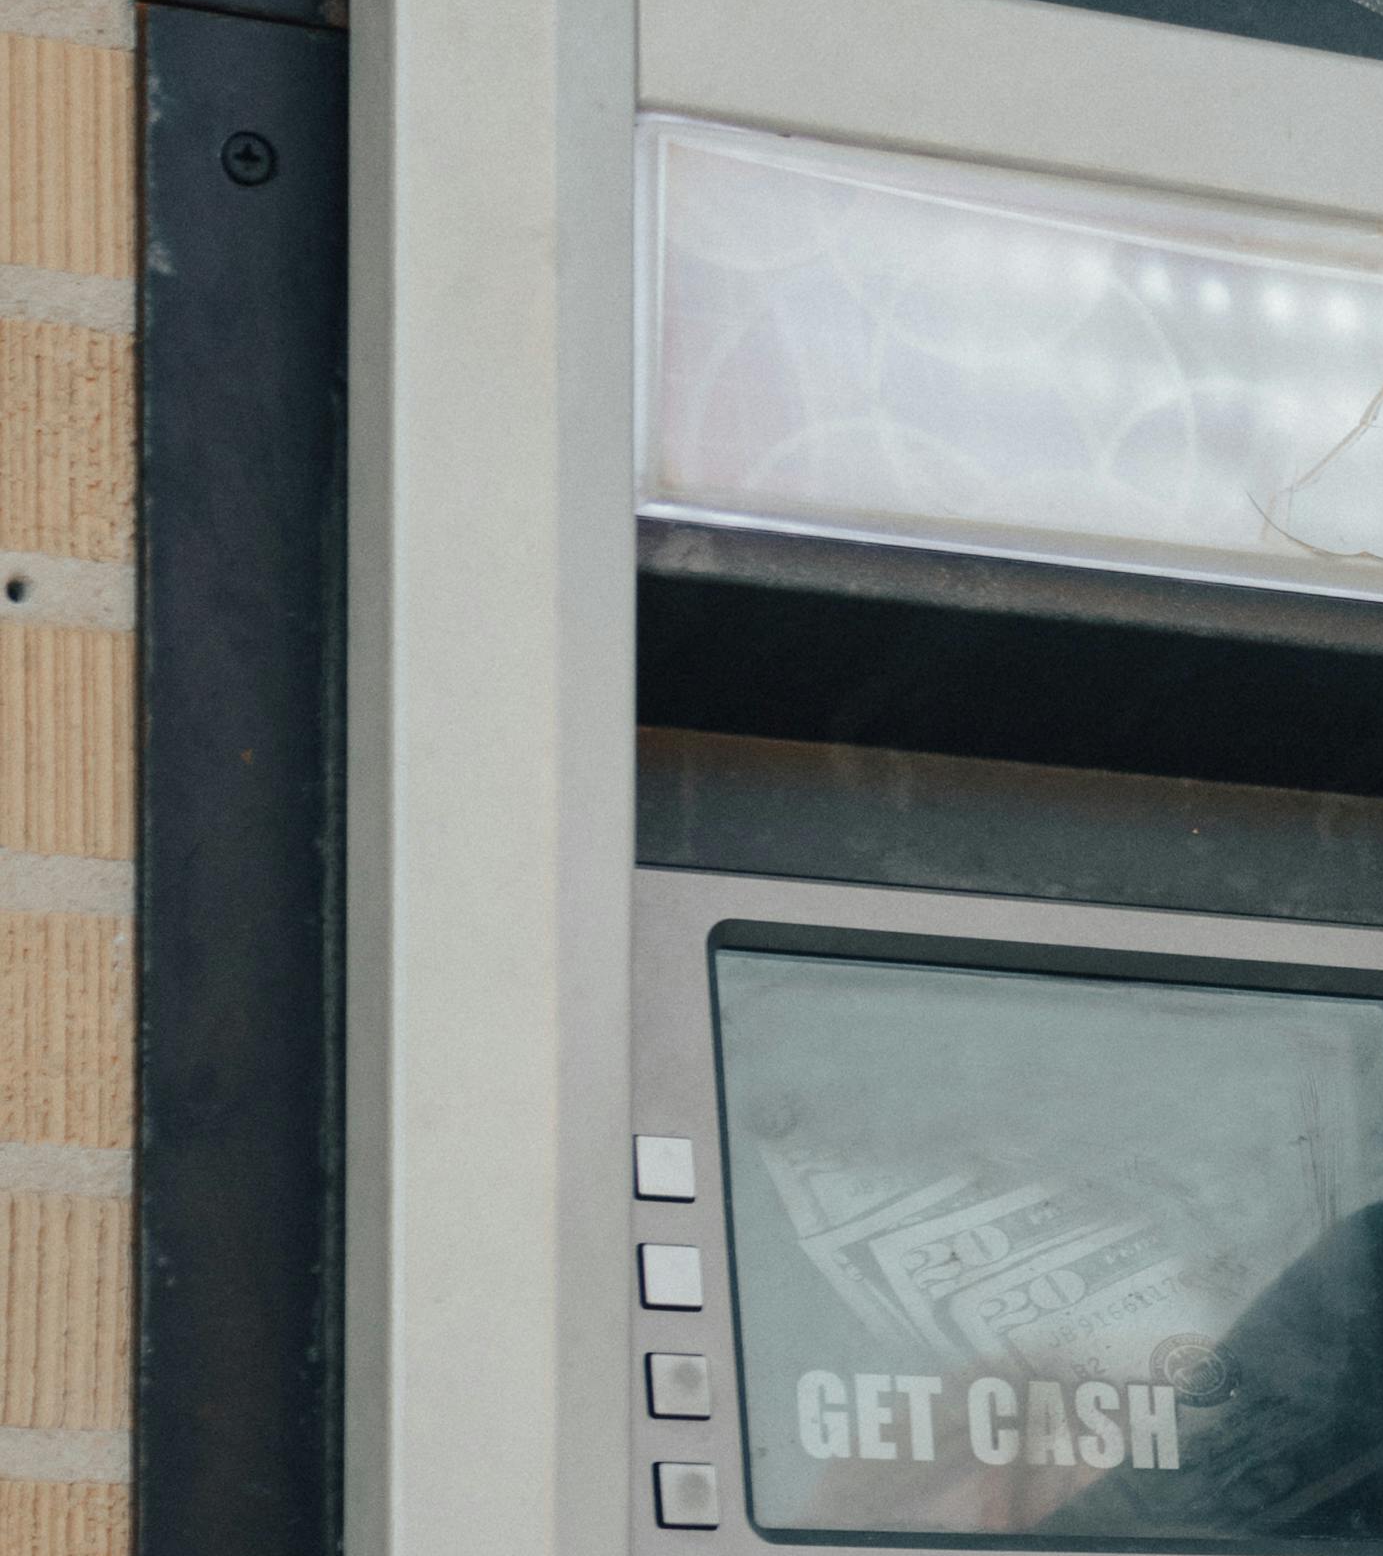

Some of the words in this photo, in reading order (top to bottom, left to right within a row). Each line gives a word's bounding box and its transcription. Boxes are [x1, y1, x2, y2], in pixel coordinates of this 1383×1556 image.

[897, 1223, 1010, 1300] 20
[975, 1268, 1086, 1332] 20
[796, 1369, 943, 1461] GET
[967, 1376, 1180, 1470] CASH
